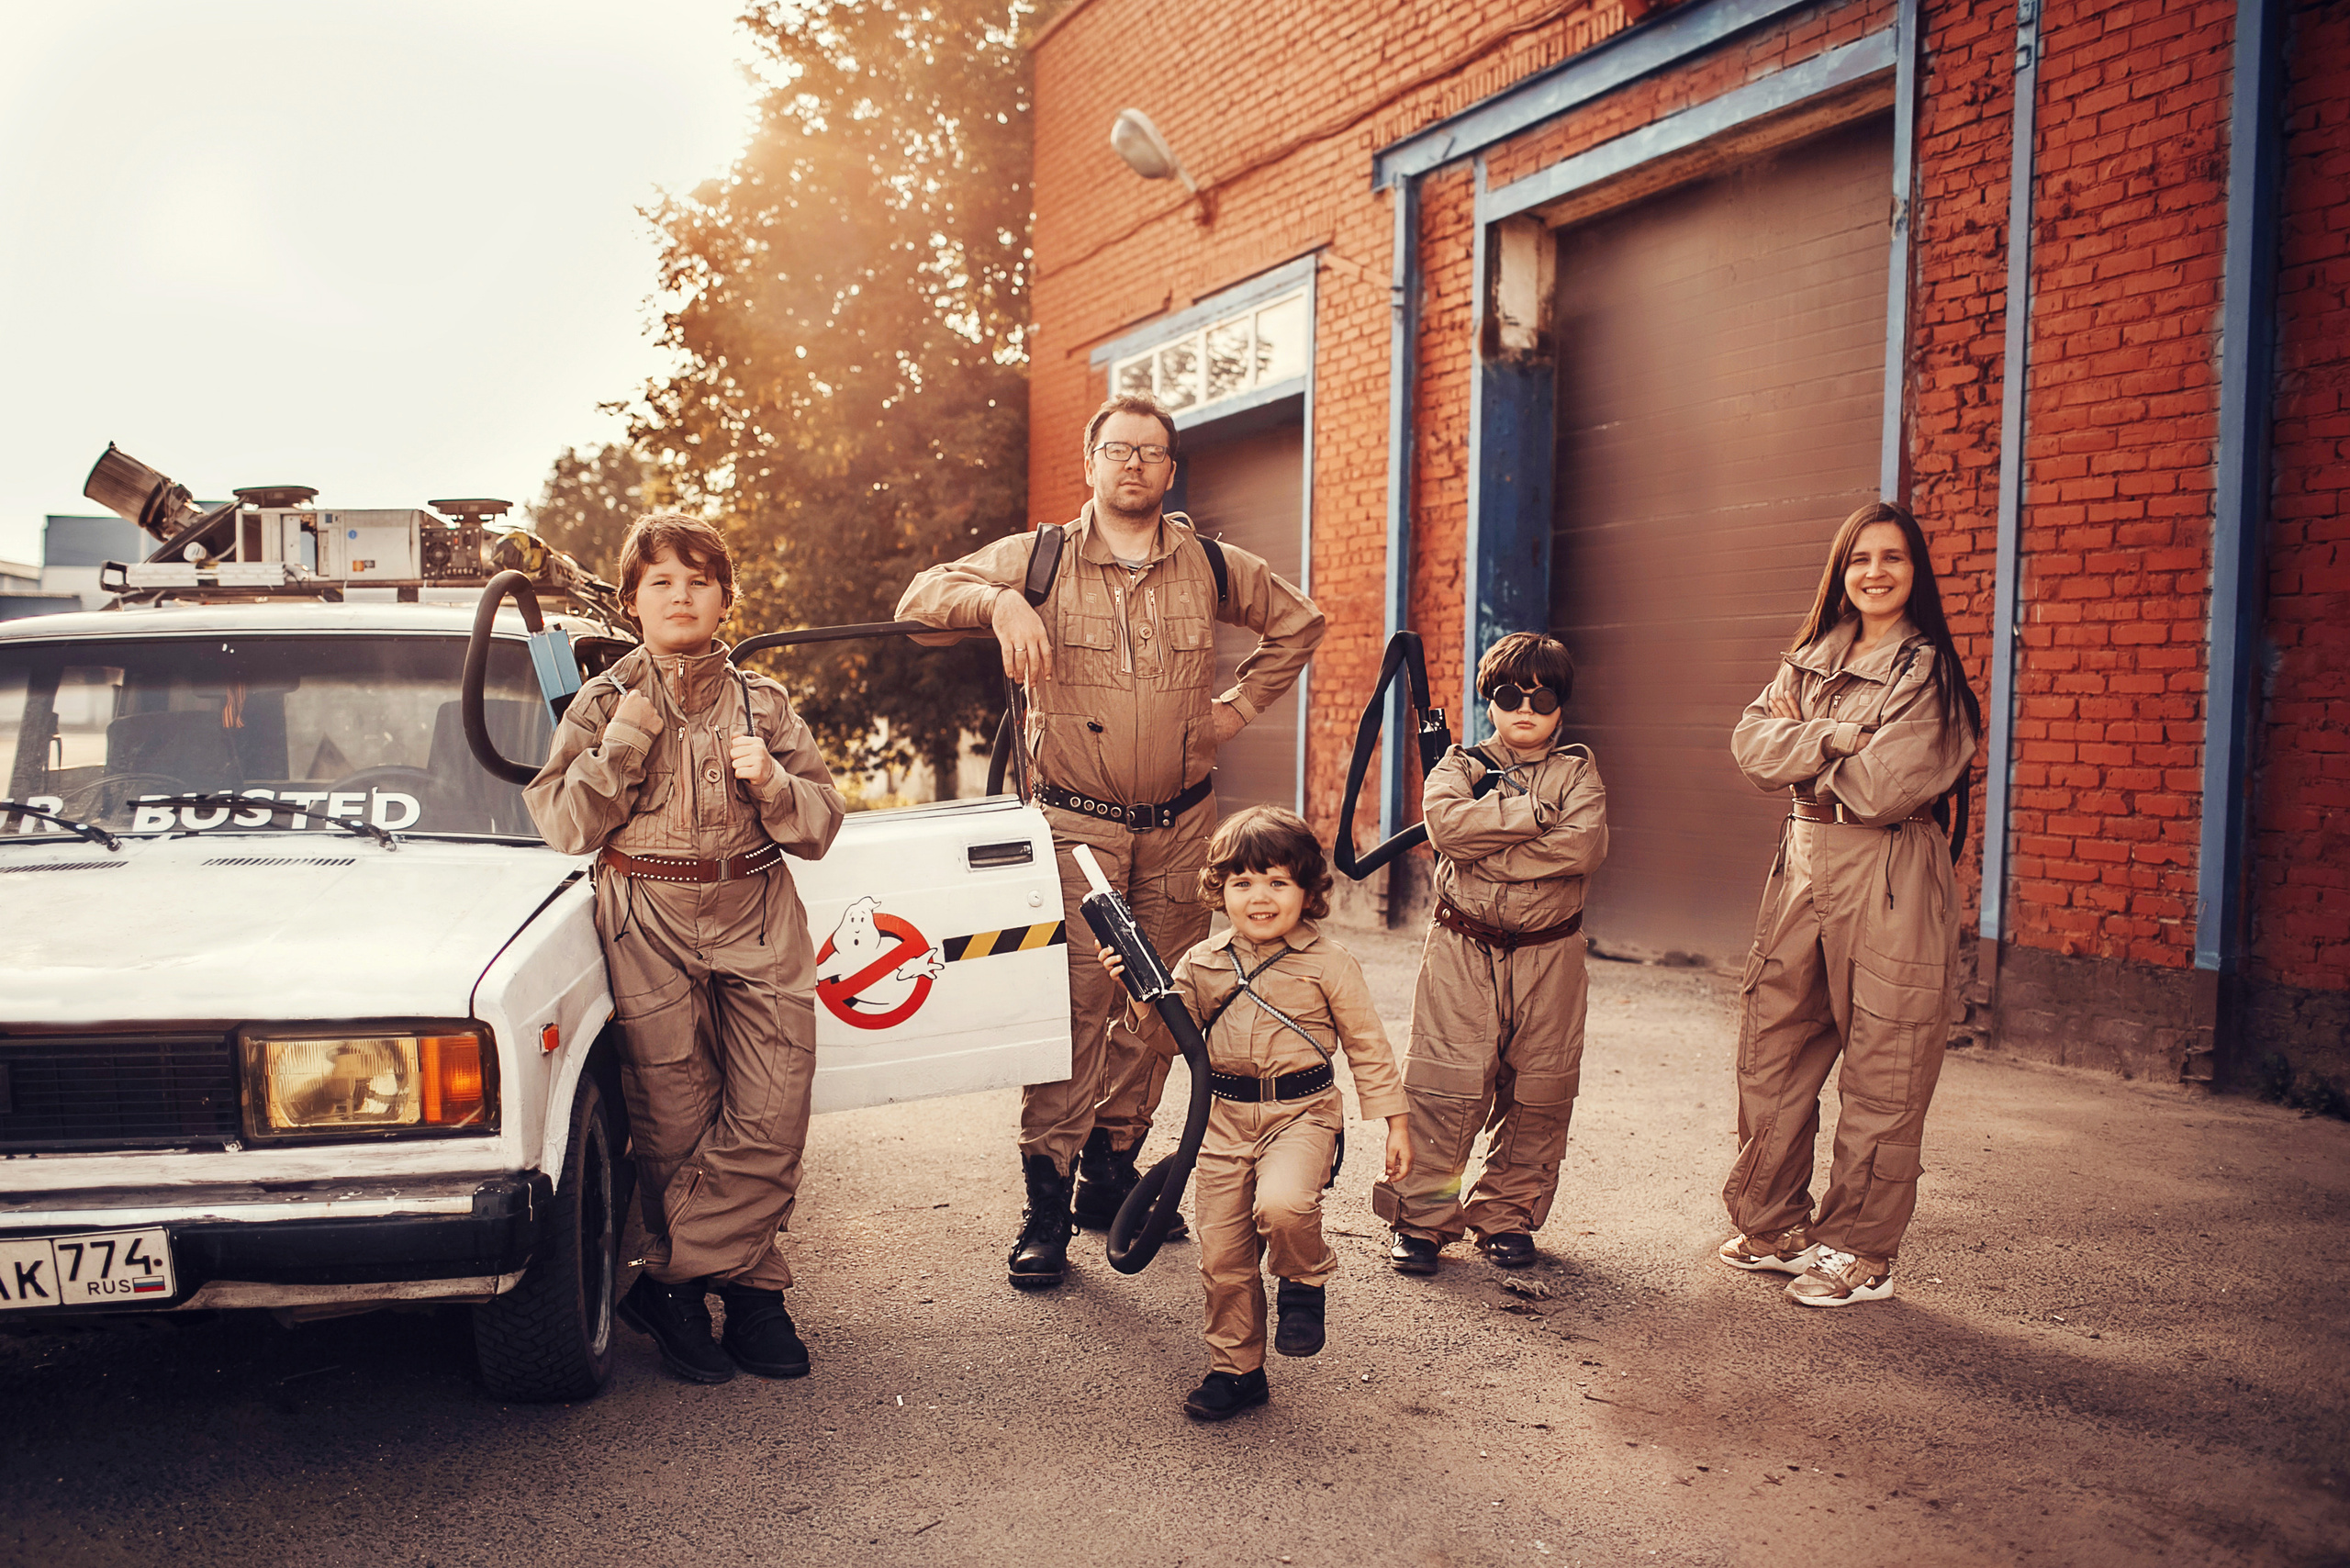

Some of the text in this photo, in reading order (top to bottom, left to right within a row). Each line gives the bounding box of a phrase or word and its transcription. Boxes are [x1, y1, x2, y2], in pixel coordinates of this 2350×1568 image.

[132, 788, 421, 832] BUSTED
[59, 1238, 151, 1282] 774
[87, 1280, 131, 1295] RUS
